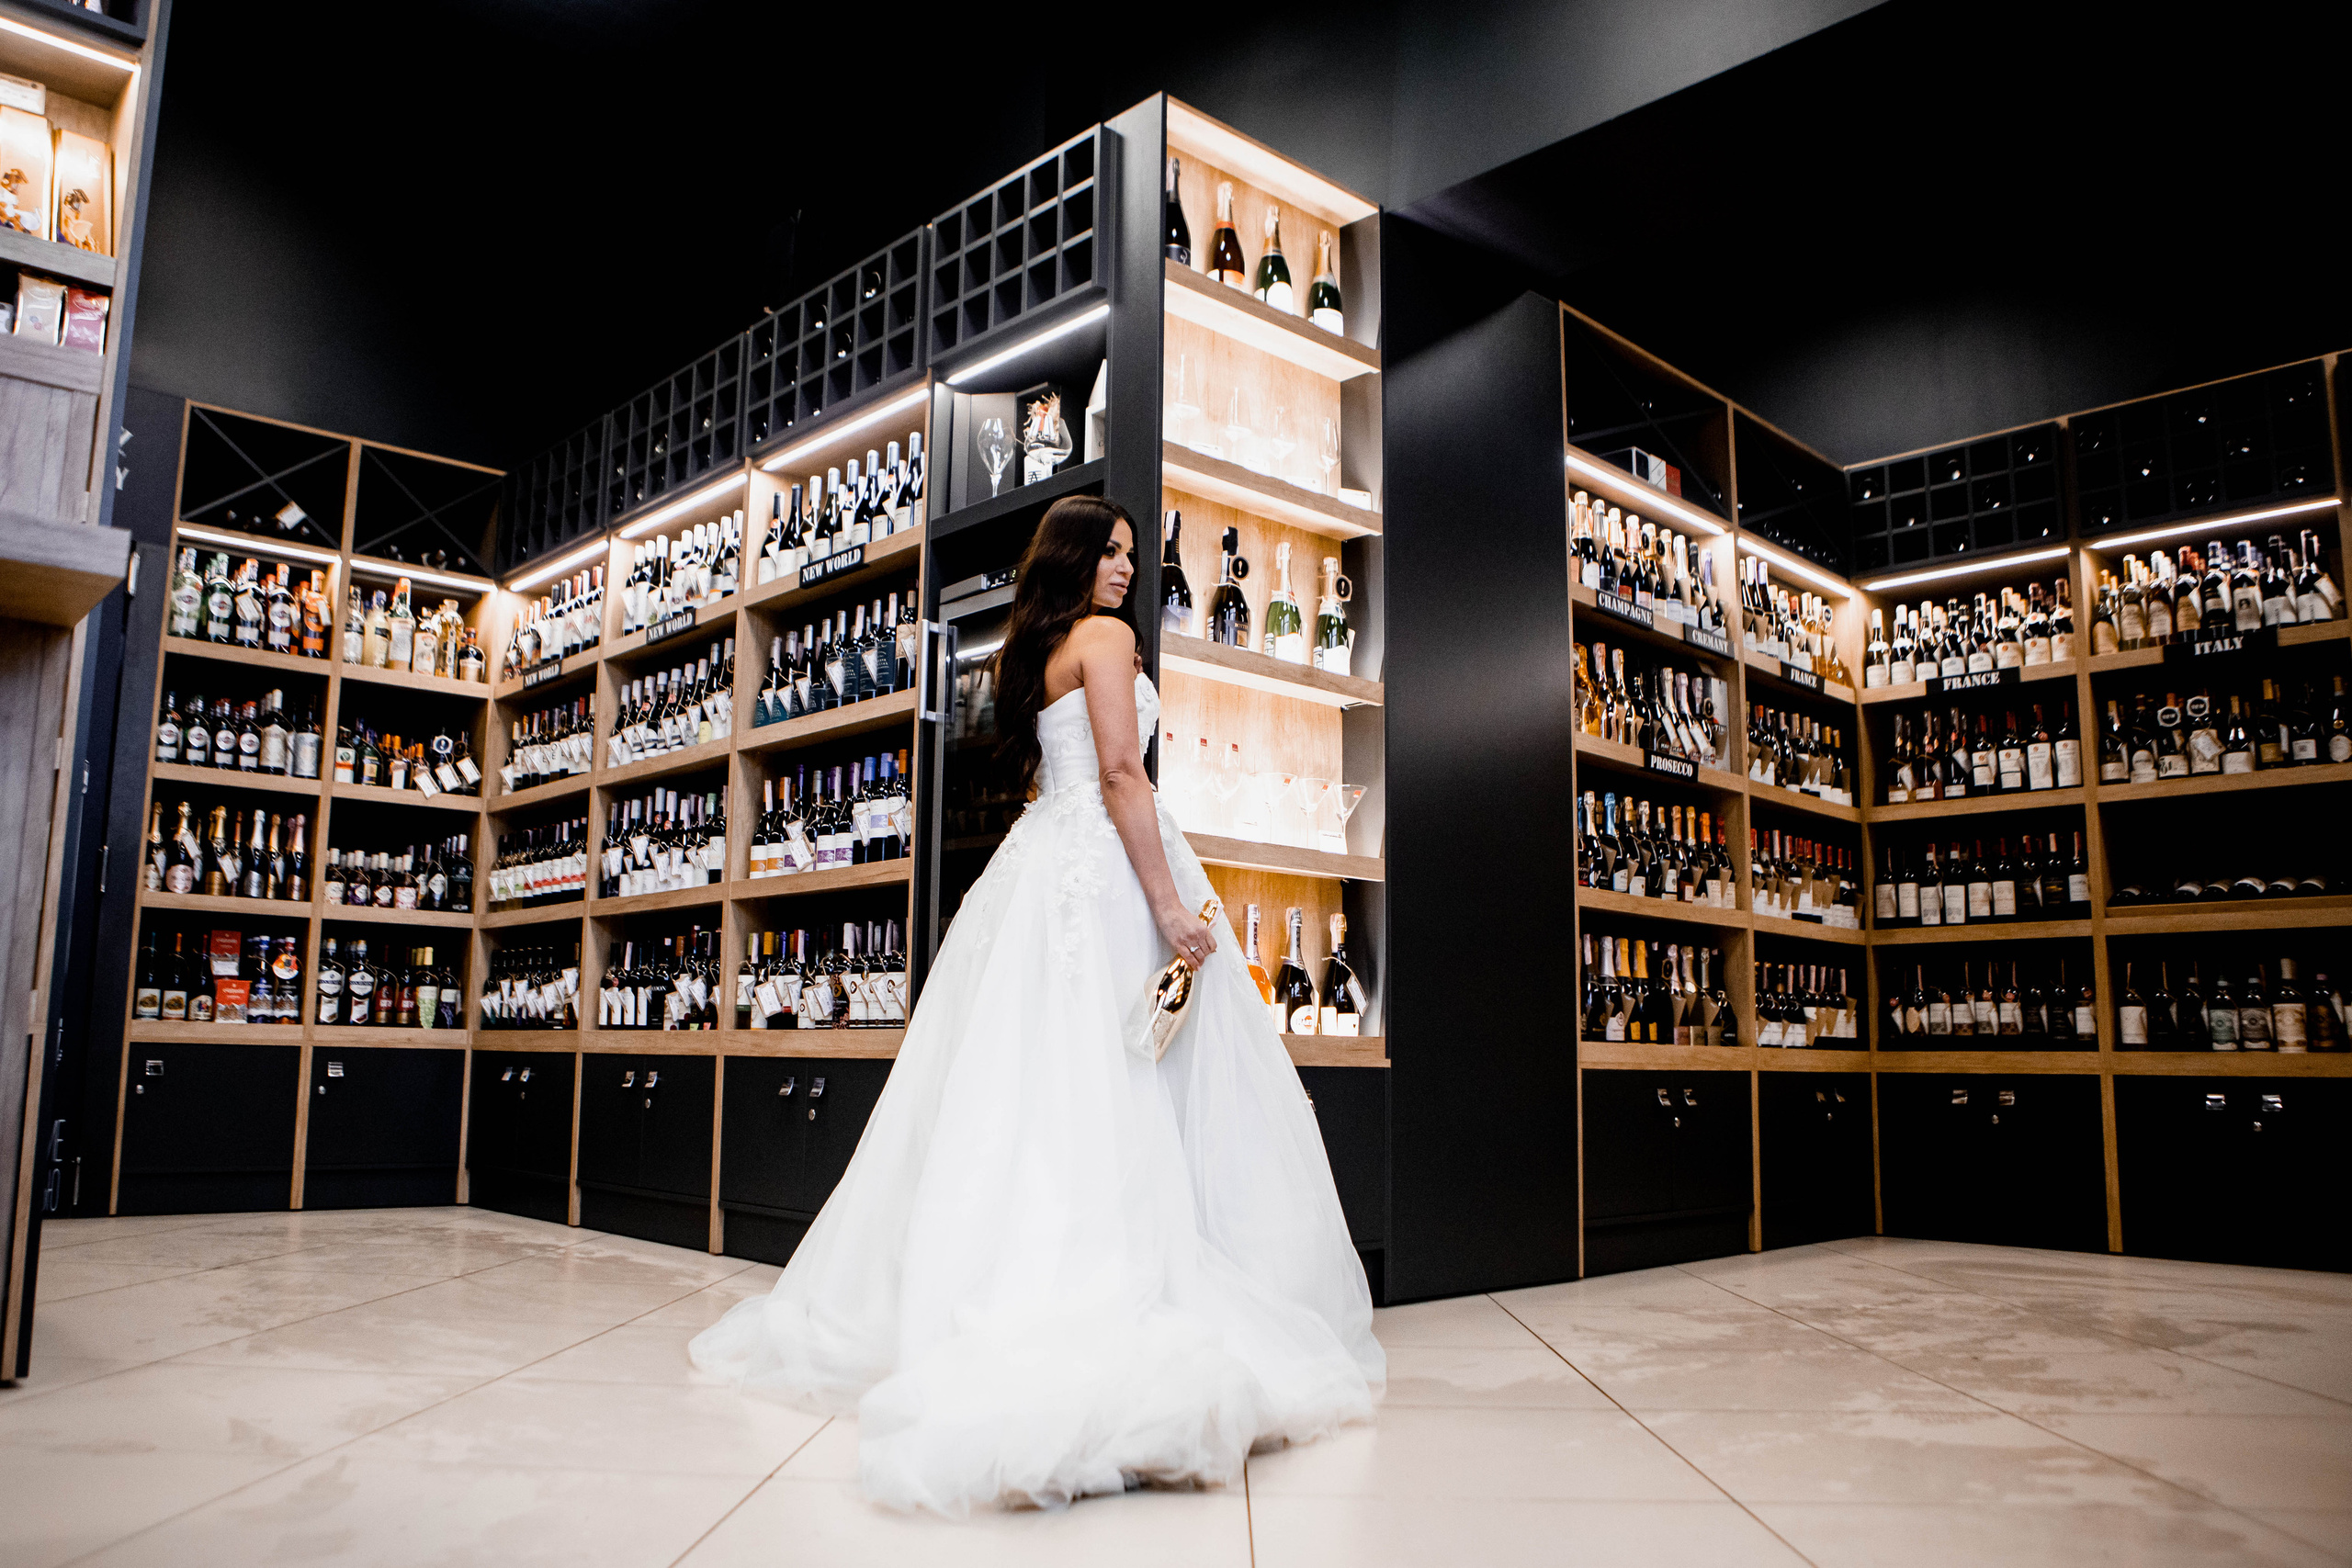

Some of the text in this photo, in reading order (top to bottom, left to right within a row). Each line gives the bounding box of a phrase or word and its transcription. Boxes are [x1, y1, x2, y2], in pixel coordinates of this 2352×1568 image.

[801, 548, 862, 583] NEW WORLD
[1599, 592, 1653, 625] CHAMPAGNE
[648, 613, 693, 642] NEW WORLD
[2194, 637, 2245, 656] ITALY
[538, 663, 560, 682] WORLD
[1791, 668, 1818, 689] FRANCE
[1942, 671, 2001, 692] FRANCE
[1650, 754, 1694, 778] PROSECCO
